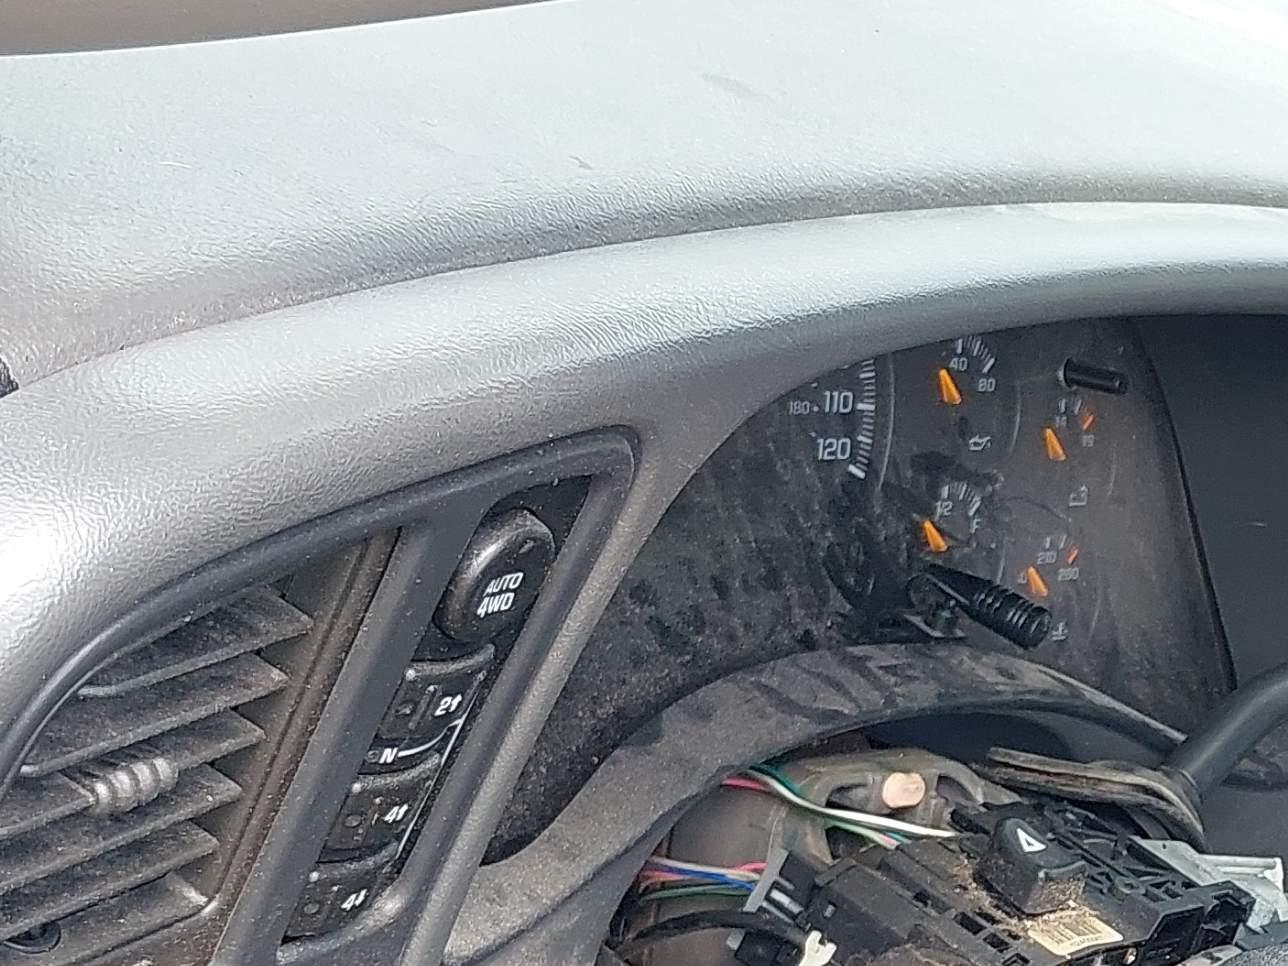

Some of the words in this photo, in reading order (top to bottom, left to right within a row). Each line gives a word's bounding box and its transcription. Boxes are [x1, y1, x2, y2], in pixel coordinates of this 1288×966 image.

[948, 357, 968, 372] 40
[789, 401, 811, 415] 180
[824, 390, 854, 414] 110
[817, 438, 851, 461] 120
[482, 571, 524, 598] AUTO
[476, 592, 516, 618] 4WD
[378, 747, 400, 764] N
